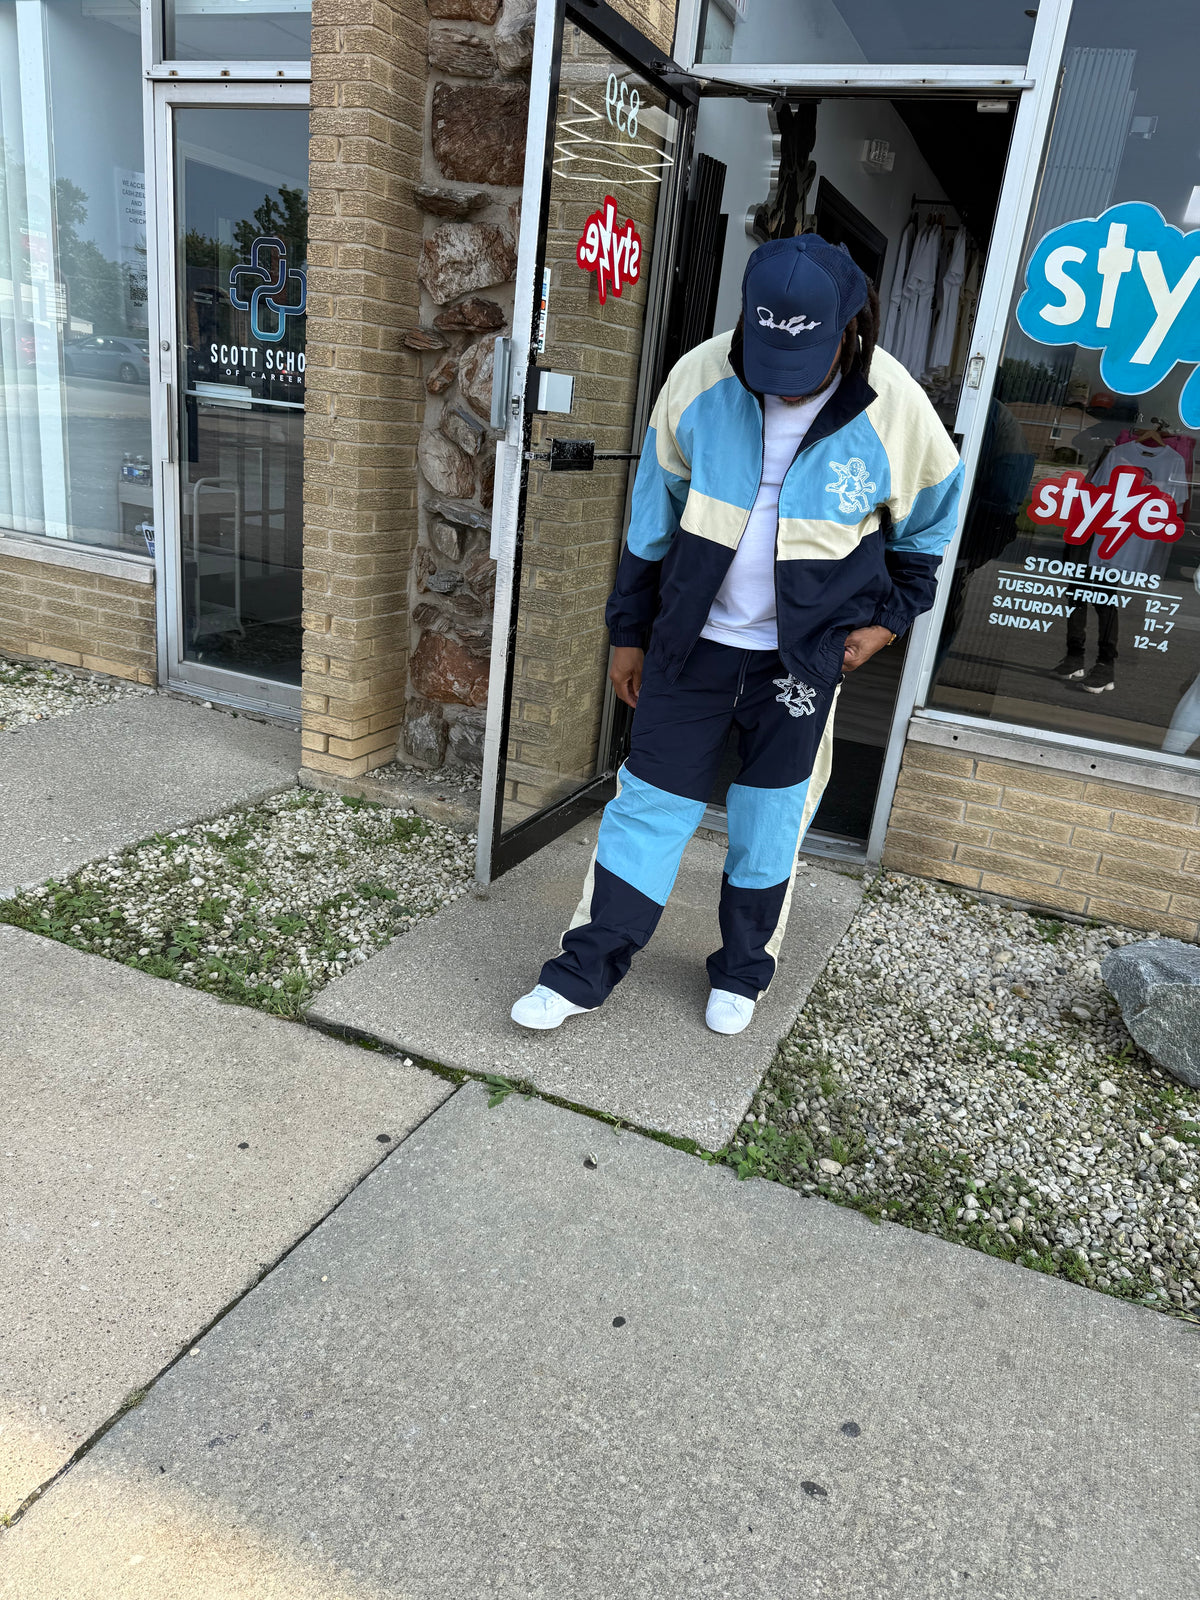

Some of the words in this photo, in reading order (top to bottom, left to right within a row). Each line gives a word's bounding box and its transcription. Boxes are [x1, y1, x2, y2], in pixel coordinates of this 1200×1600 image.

[131, 199, 143, 207] AND
[210, 343, 258, 368] SCOTT
[265, 349, 306, 373] SCHO
[225, 368, 240, 377] OF
[251, 371, 302, 384] CAREER
[1023, 556, 1088, 579] STORE
[1089, 566, 1161, 590] HOURS
[997, 577, 1132, 609] TUESDAY-FRIDAY
[1145, 599, 1180, 616] 12-7
[992, 594, 1076, 619] SATURDAY
[1143, 617, 1175, 635] 11-7
[988, 612, 1053, 633] SUNDAY
[1133, 635, 1169, 653] 12-4
